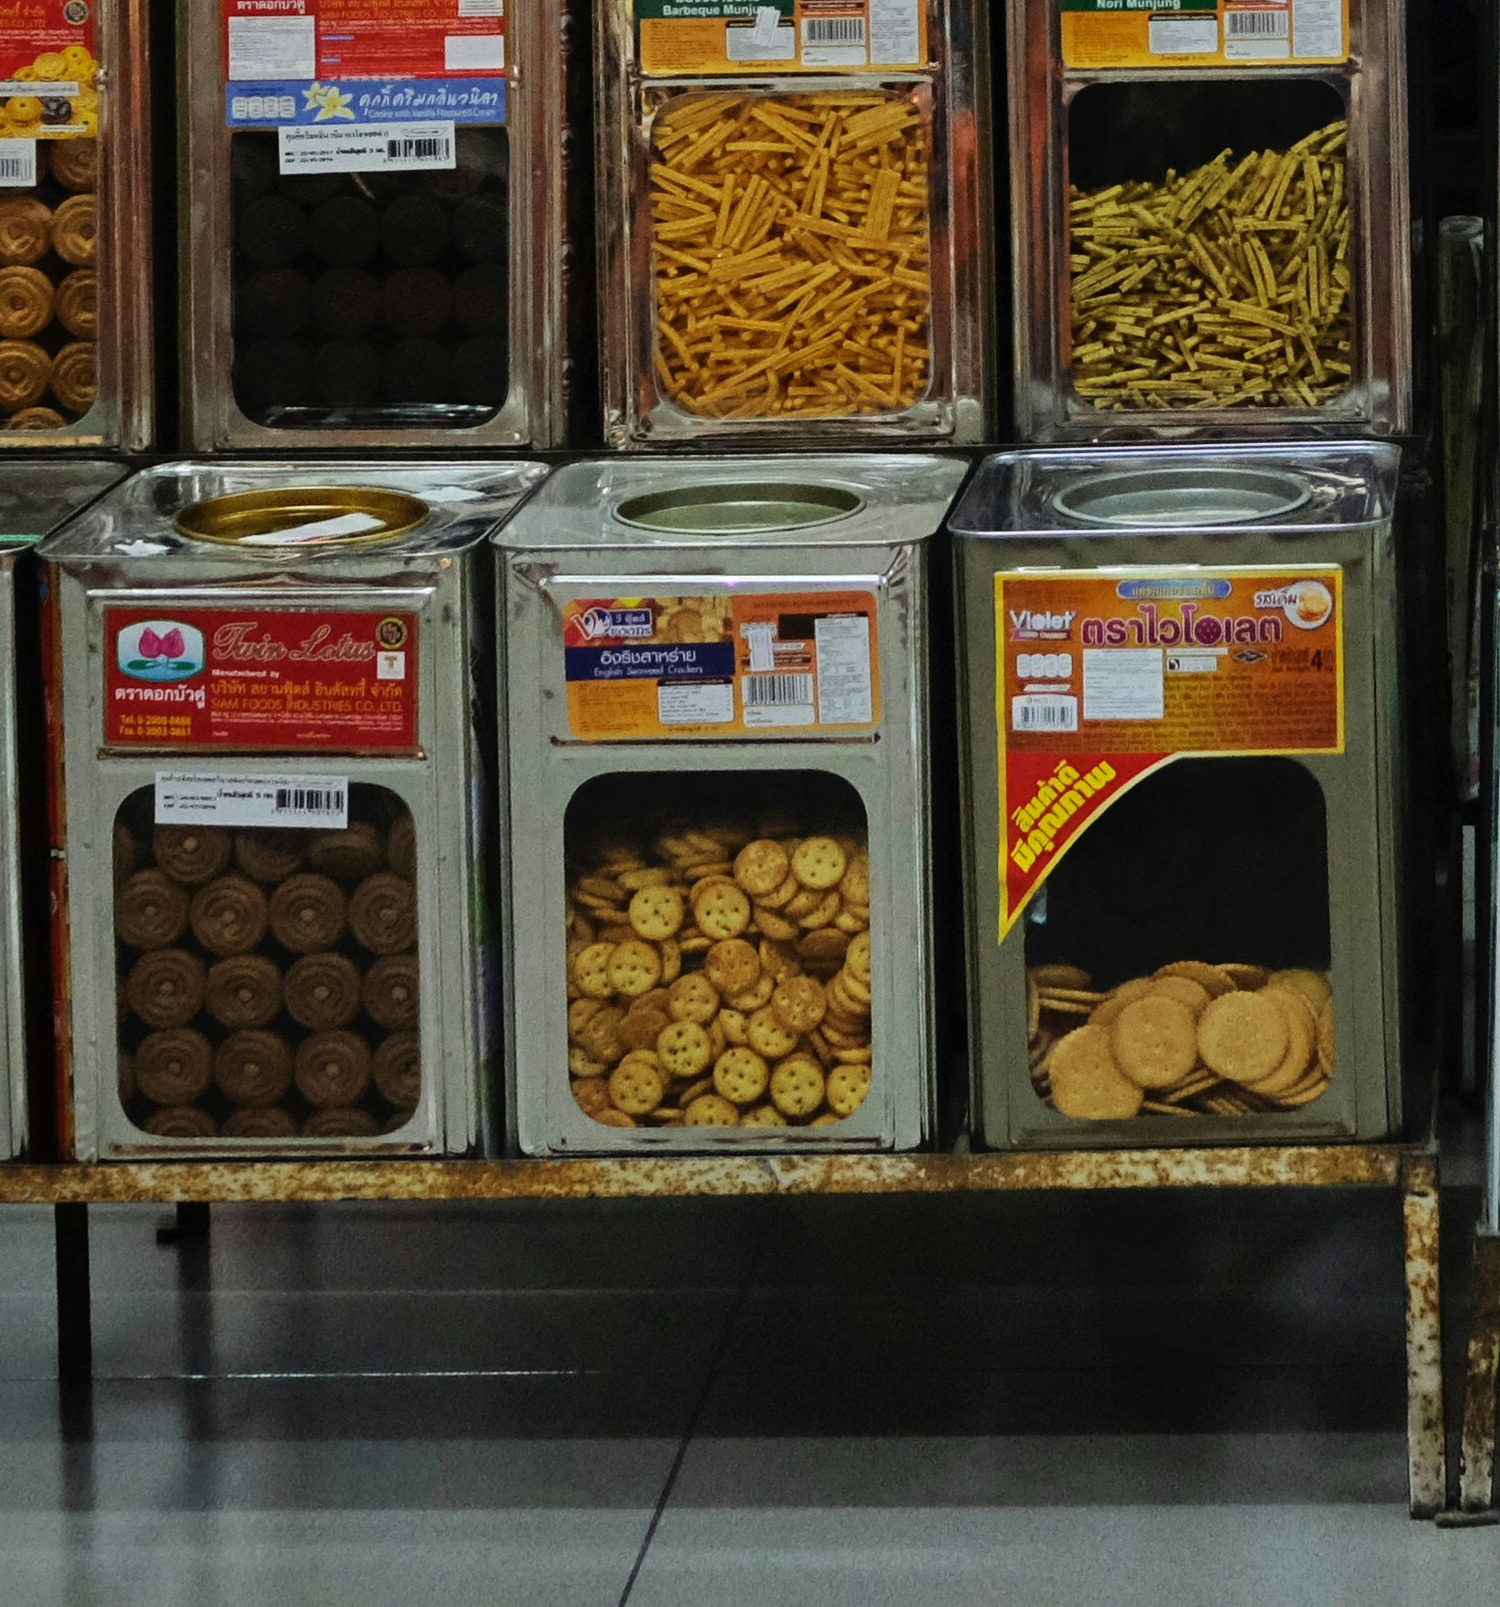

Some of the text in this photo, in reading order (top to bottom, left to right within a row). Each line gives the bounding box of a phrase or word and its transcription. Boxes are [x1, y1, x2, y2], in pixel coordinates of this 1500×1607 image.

[662, 4, 721, 17] Barbeque
[1009, 609, 1075, 631] Violet
[1081, 602, 1283, 647] ตราไวโอเลต
[212, 621, 376, 662] Twin Lotus
[1310, 650, 1323, 671] 4
[114, 684, 206, 709] ตราดอกบัวคู่
[210, 680, 246, 696] บริษัท
[210, 698, 353, 712] SIAM FOODS INDUSTRIES
[1011, 759, 1081, 834] สินค้าดี
[1012, 759, 1118, 873] มีคุณภาพ
